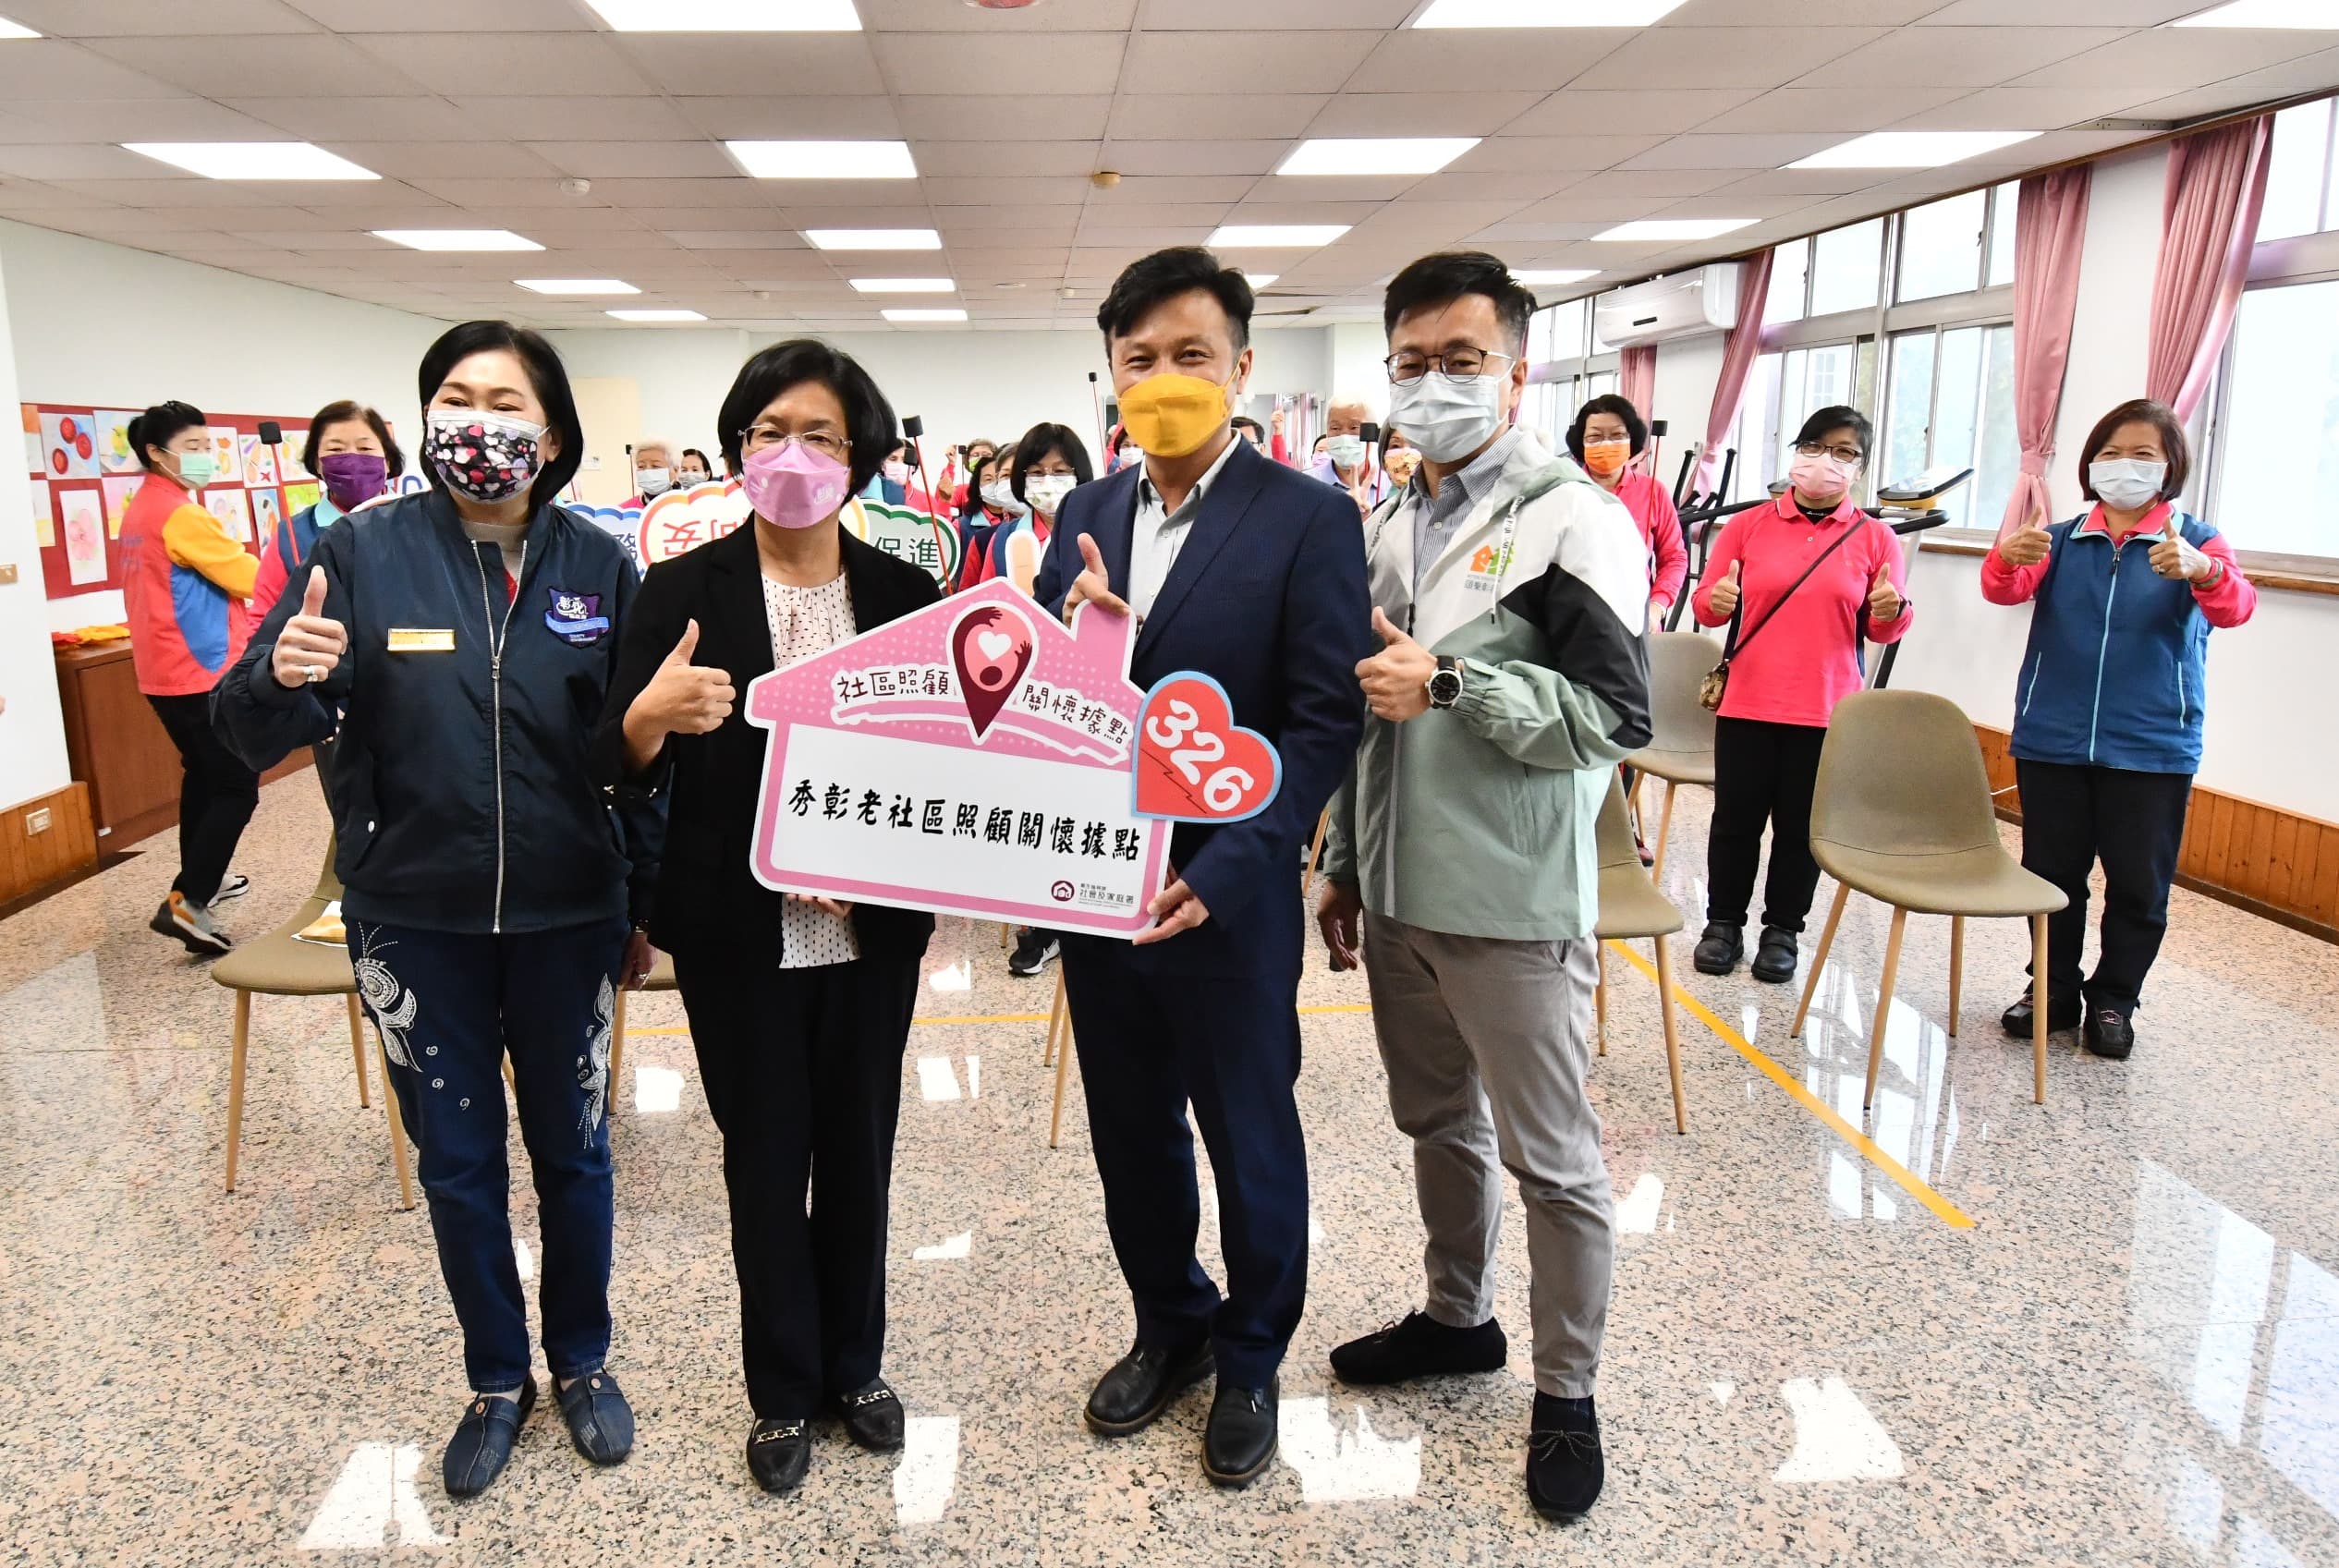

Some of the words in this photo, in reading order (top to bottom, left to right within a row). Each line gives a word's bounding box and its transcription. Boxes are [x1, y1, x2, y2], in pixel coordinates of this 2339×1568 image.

[836, 669, 949, 703] 社區照顧
[1023, 684, 1128, 744] 關懷據點
[1146, 699, 1254, 811] 326
[788, 779, 1139, 861] 秀彰老社區照顧關懷據點
